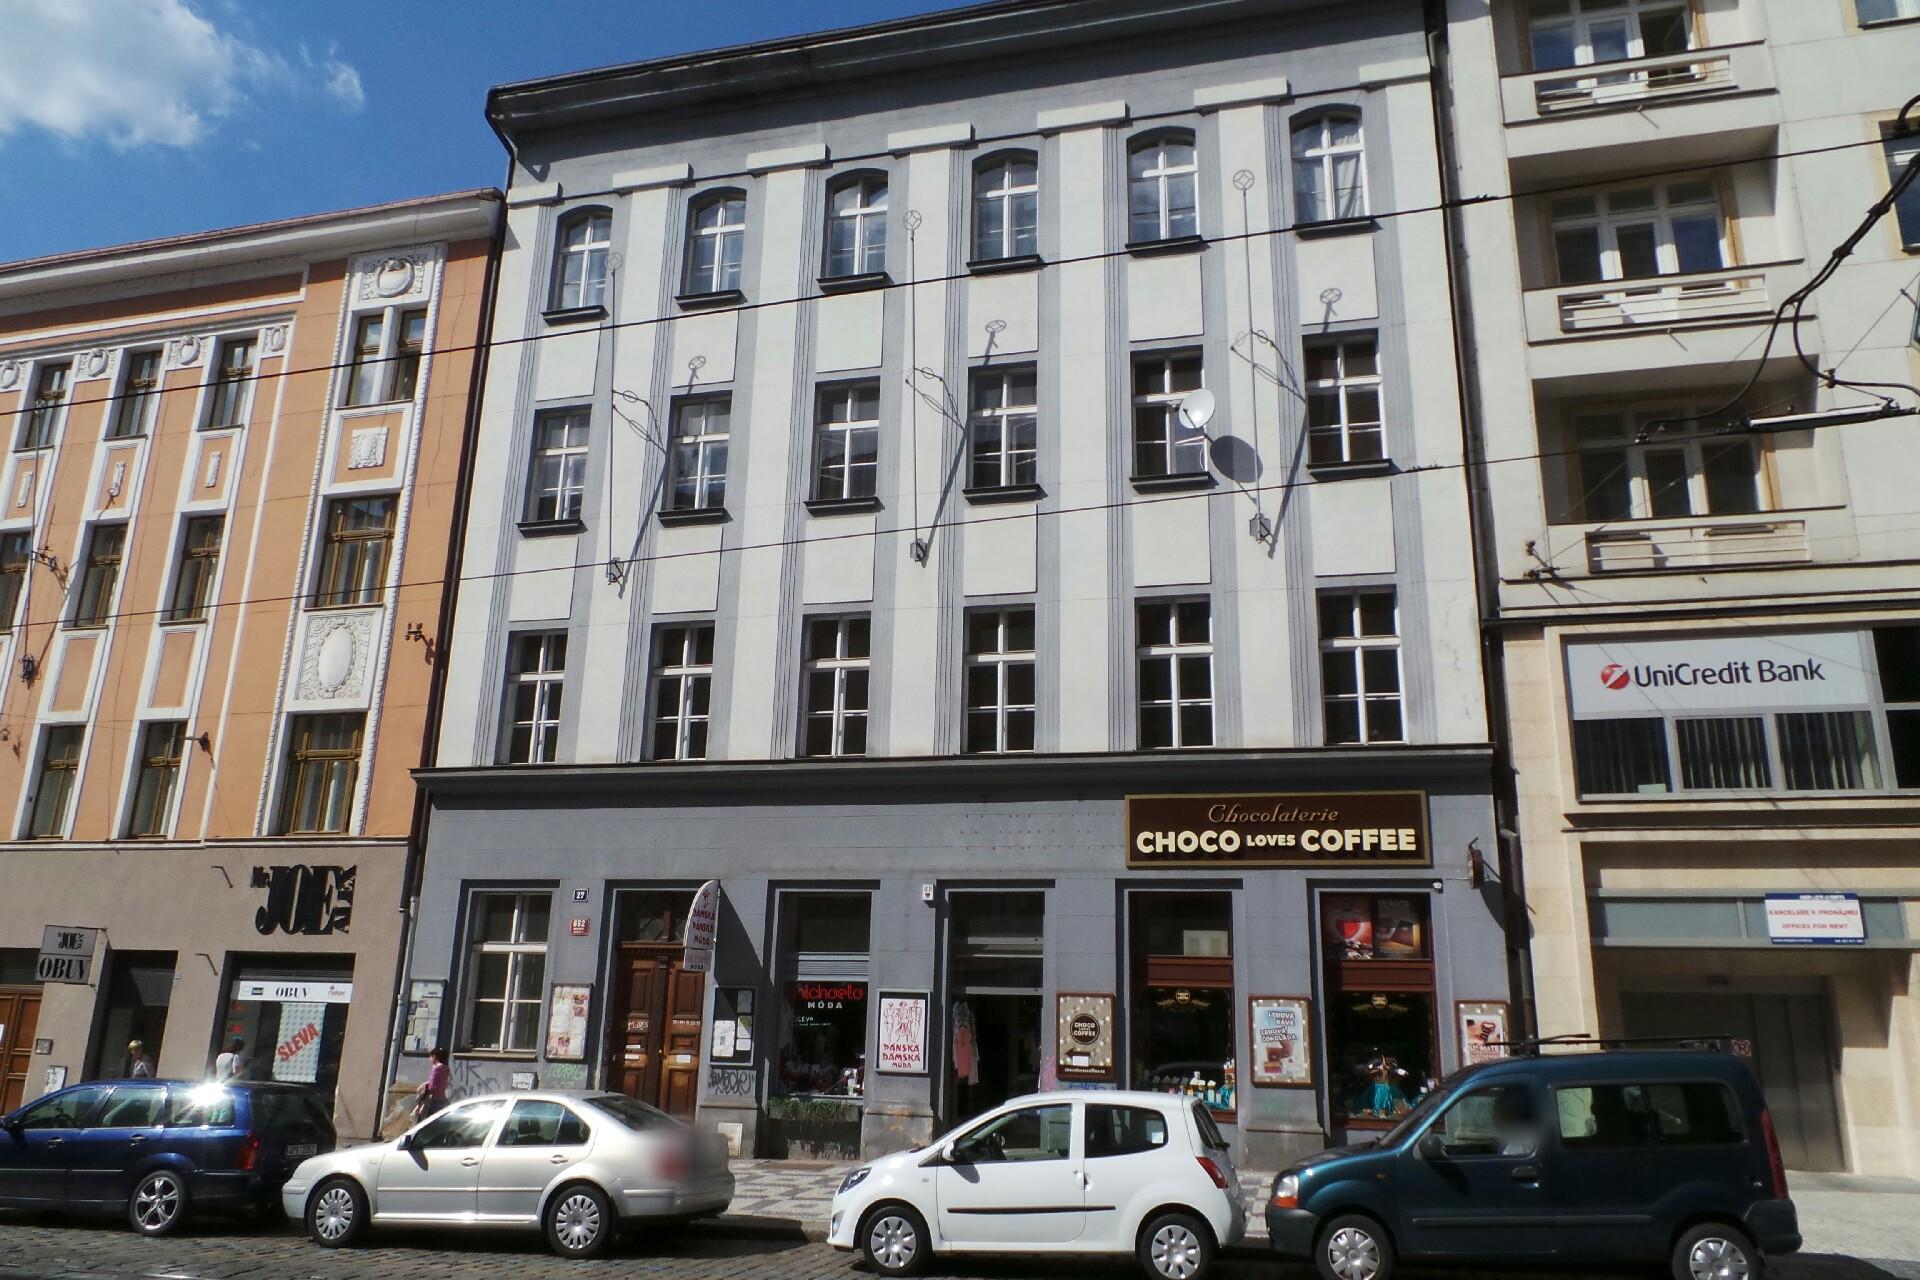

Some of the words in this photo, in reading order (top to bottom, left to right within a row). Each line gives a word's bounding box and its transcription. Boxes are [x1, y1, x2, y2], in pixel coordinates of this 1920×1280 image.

[1634, 661, 1752, 688] UniCredit
[1758, 658, 1826, 683] Bank
[1208, 803, 1339, 823] Chocolaterie
[1136, 830, 1241, 853] CHOCO
[1246, 834, 1296, 847] LOVES
[1301, 828, 1417, 852] COFFEE
[255, 864, 343, 935] JOE
[576, 891, 586, 900] 27
[275, 987, 309, 998] OBUV
[807, 1000, 843, 1009] MÓDA
[277, 1022, 319, 1062] SLEVA
